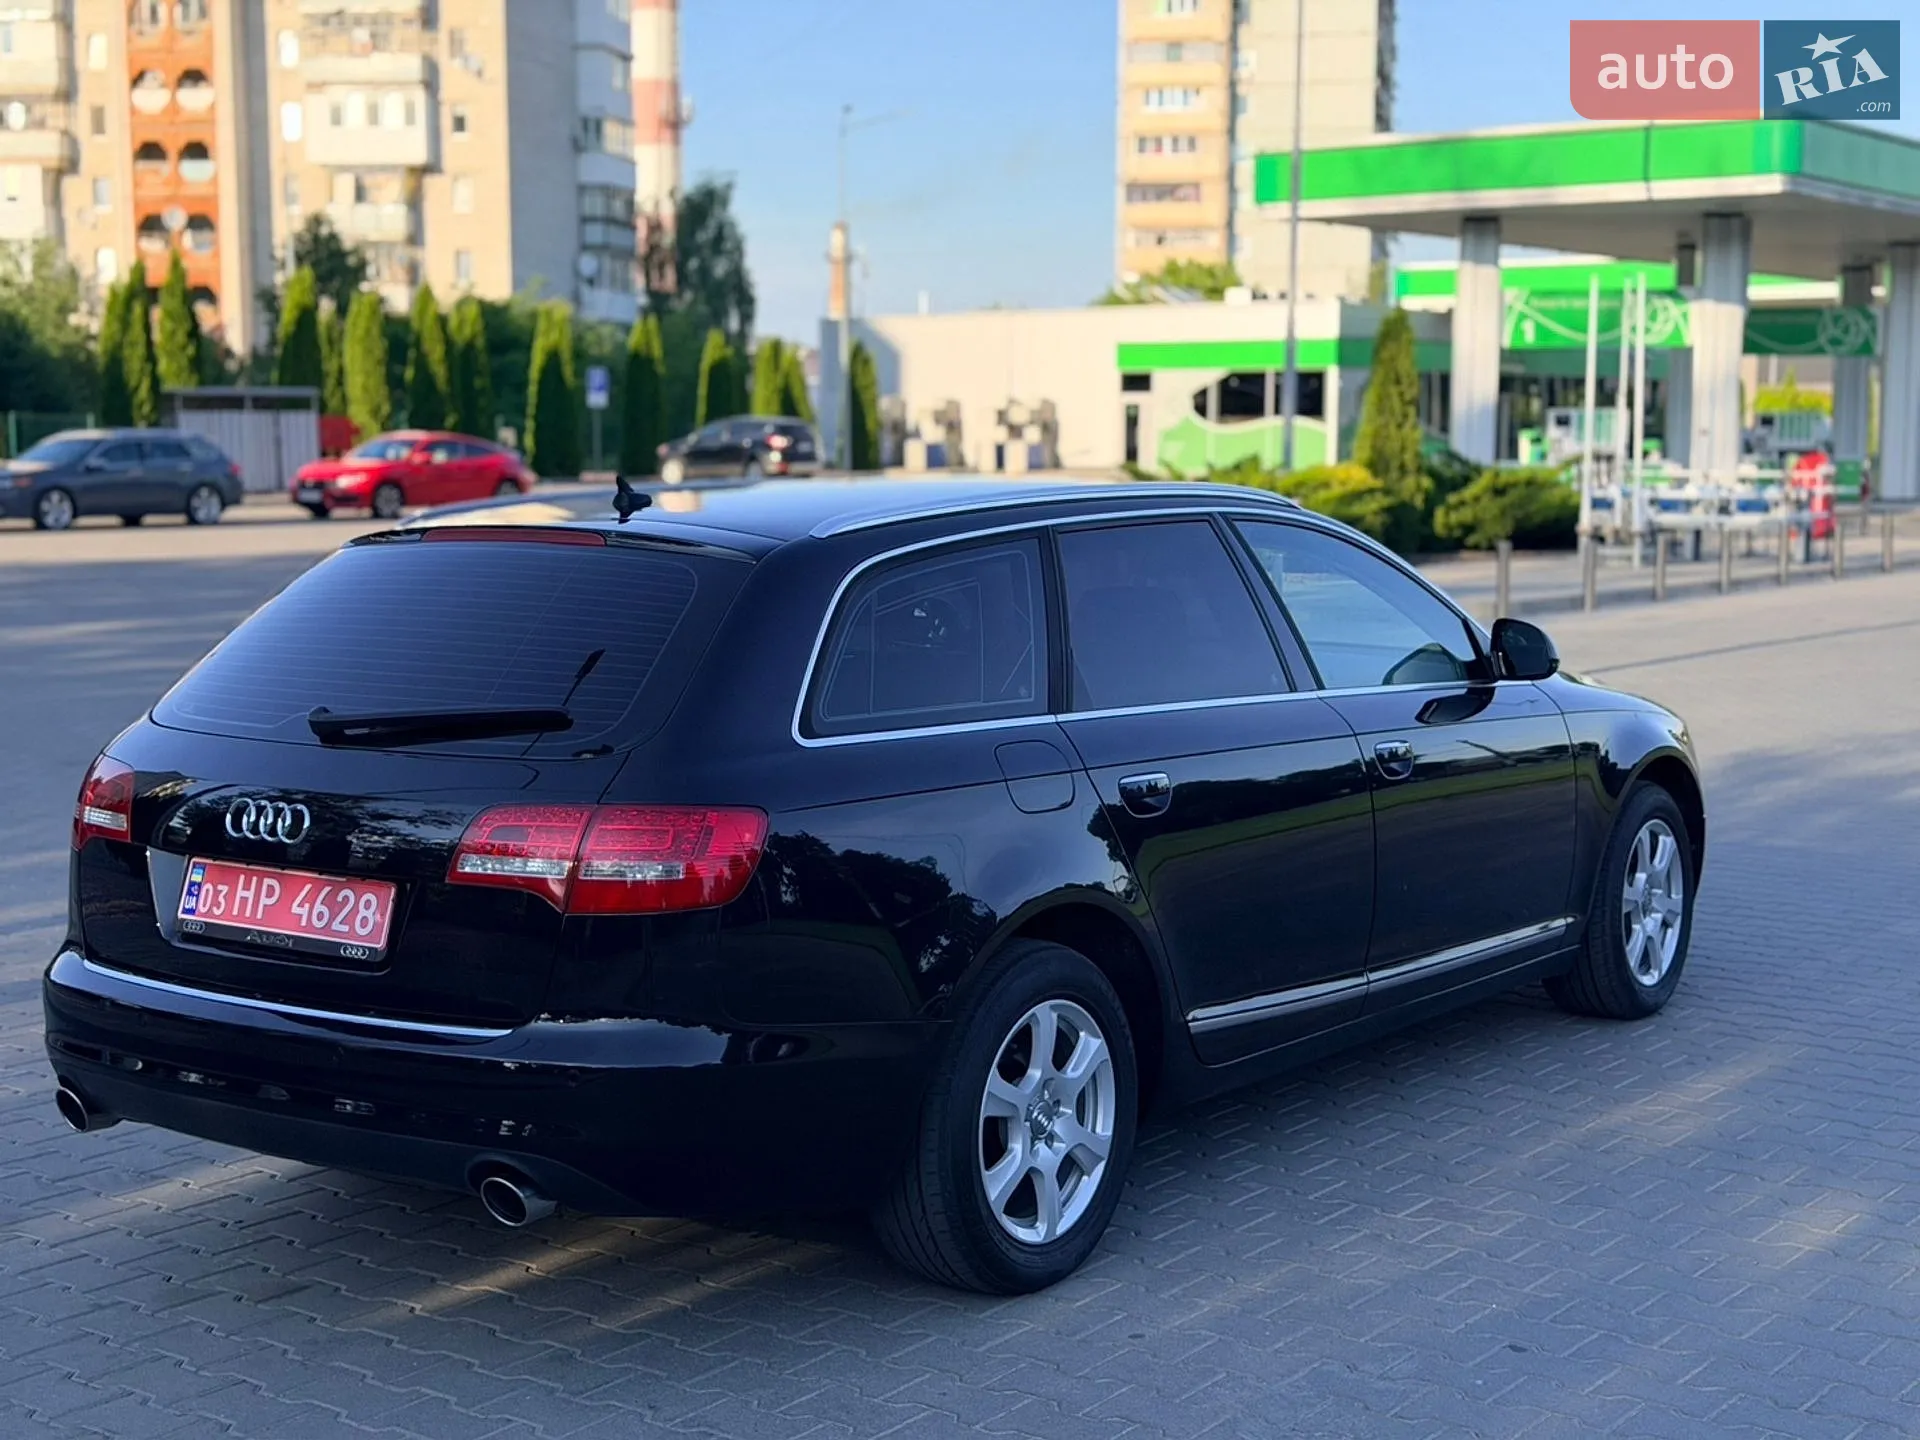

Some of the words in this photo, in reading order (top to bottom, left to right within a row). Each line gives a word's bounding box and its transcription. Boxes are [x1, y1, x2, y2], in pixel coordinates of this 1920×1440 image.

[183, 895, 197, 910] UA
[198, 882, 228, 916] 03
[232, 874, 281, 920] HP
[291, 883, 378, 936] 4628
